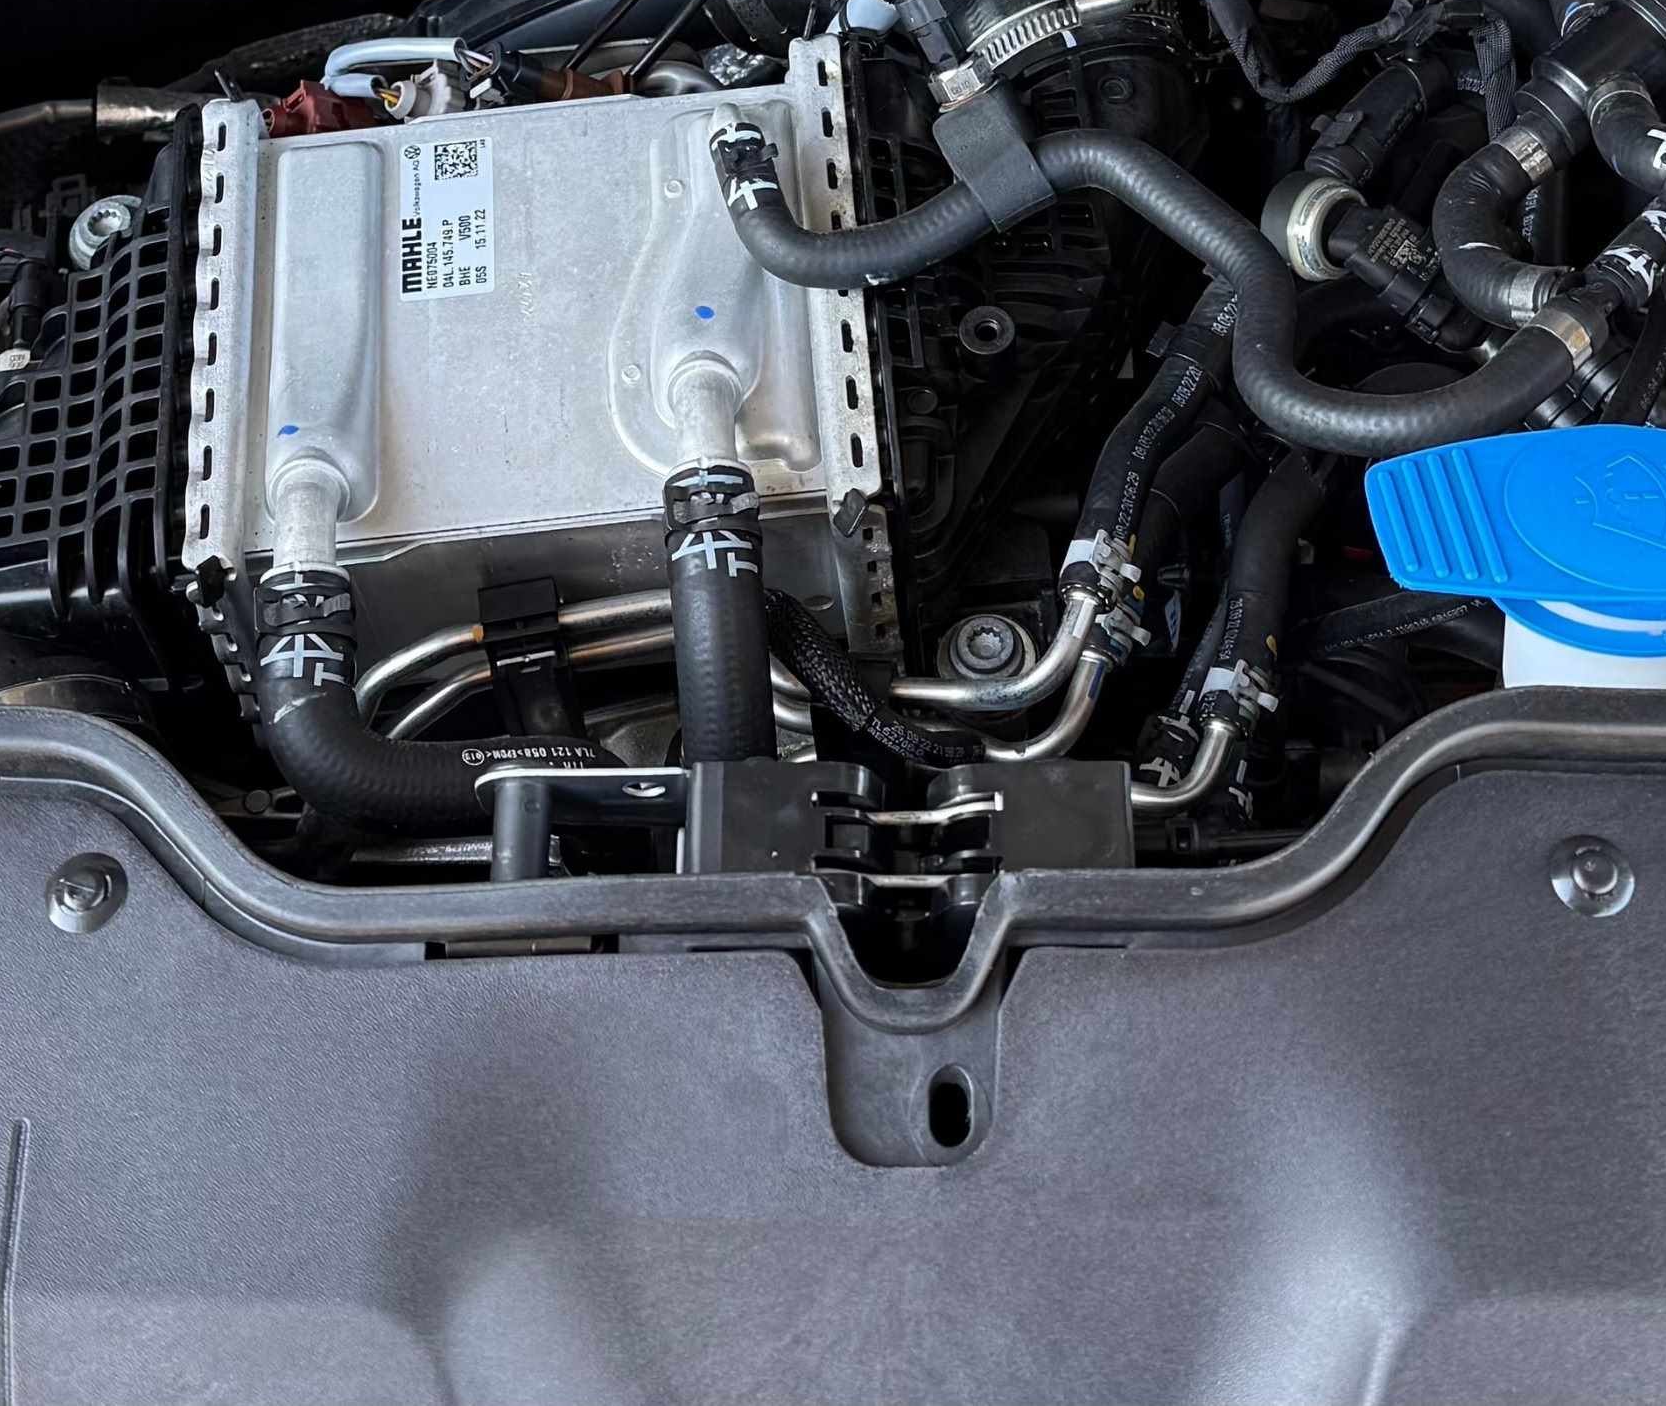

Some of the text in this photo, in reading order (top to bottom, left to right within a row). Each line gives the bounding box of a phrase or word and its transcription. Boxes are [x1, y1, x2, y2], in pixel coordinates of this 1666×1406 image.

[402, 217, 422, 294] MAHLE
[458, 215, 471, 286] BHE V500
